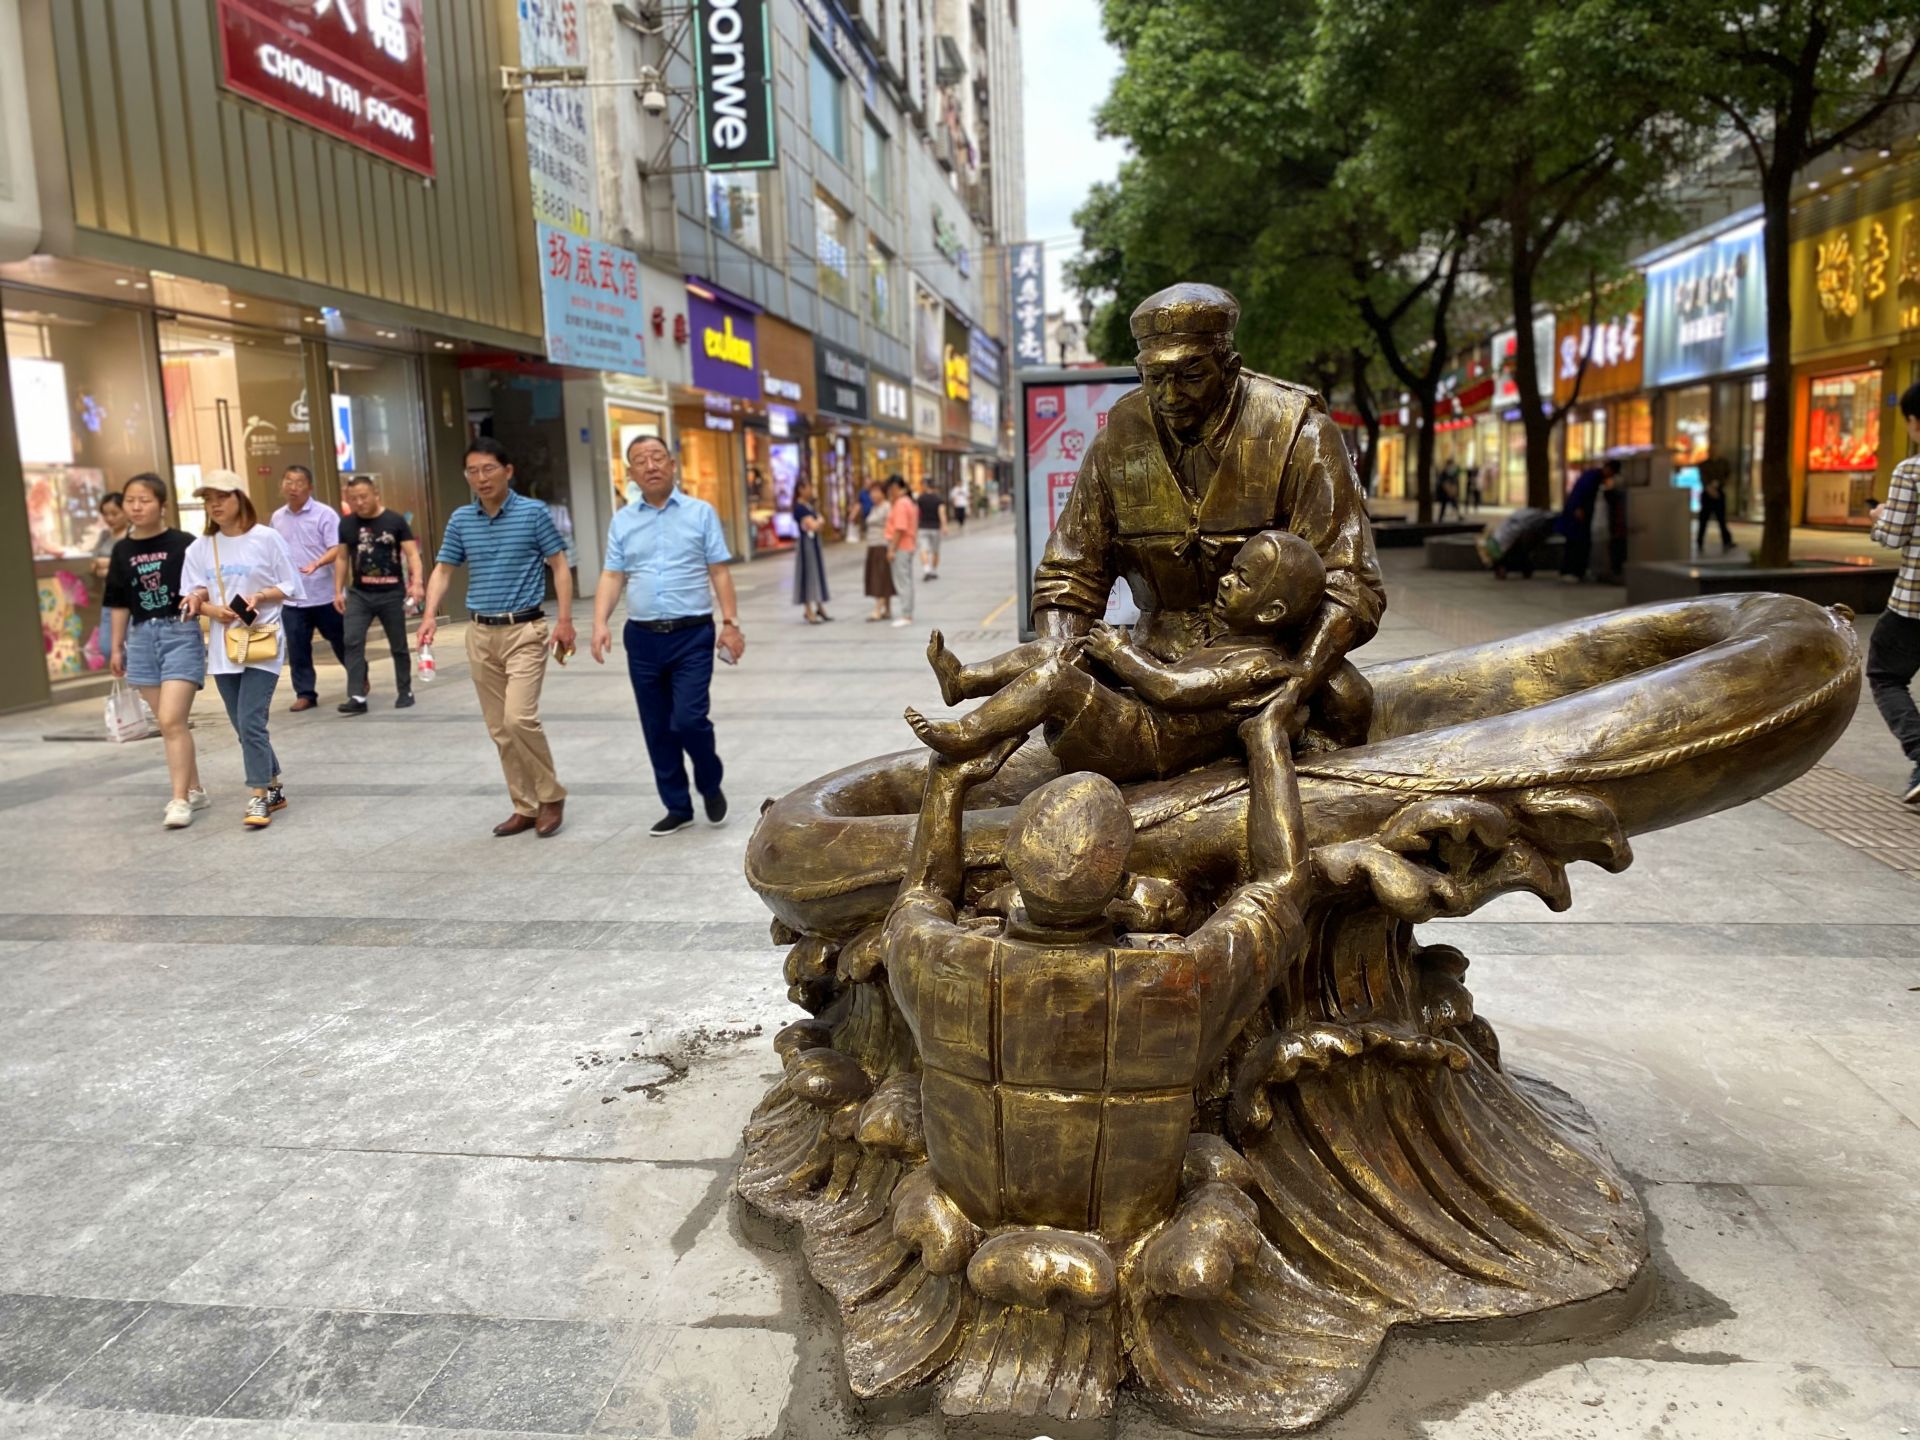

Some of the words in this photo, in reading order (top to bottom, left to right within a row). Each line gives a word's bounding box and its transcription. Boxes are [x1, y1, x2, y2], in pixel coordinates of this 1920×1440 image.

[256, 44, 325, 98] CHOW
[326, 75, 361, 115] TAI
[365, 97, 415, 141] FOOK
[708, 0, 747, 149] onwe
[548, 231, 638, 300] 扬威武馆
[137, 561, 162, 574] HAPPY
